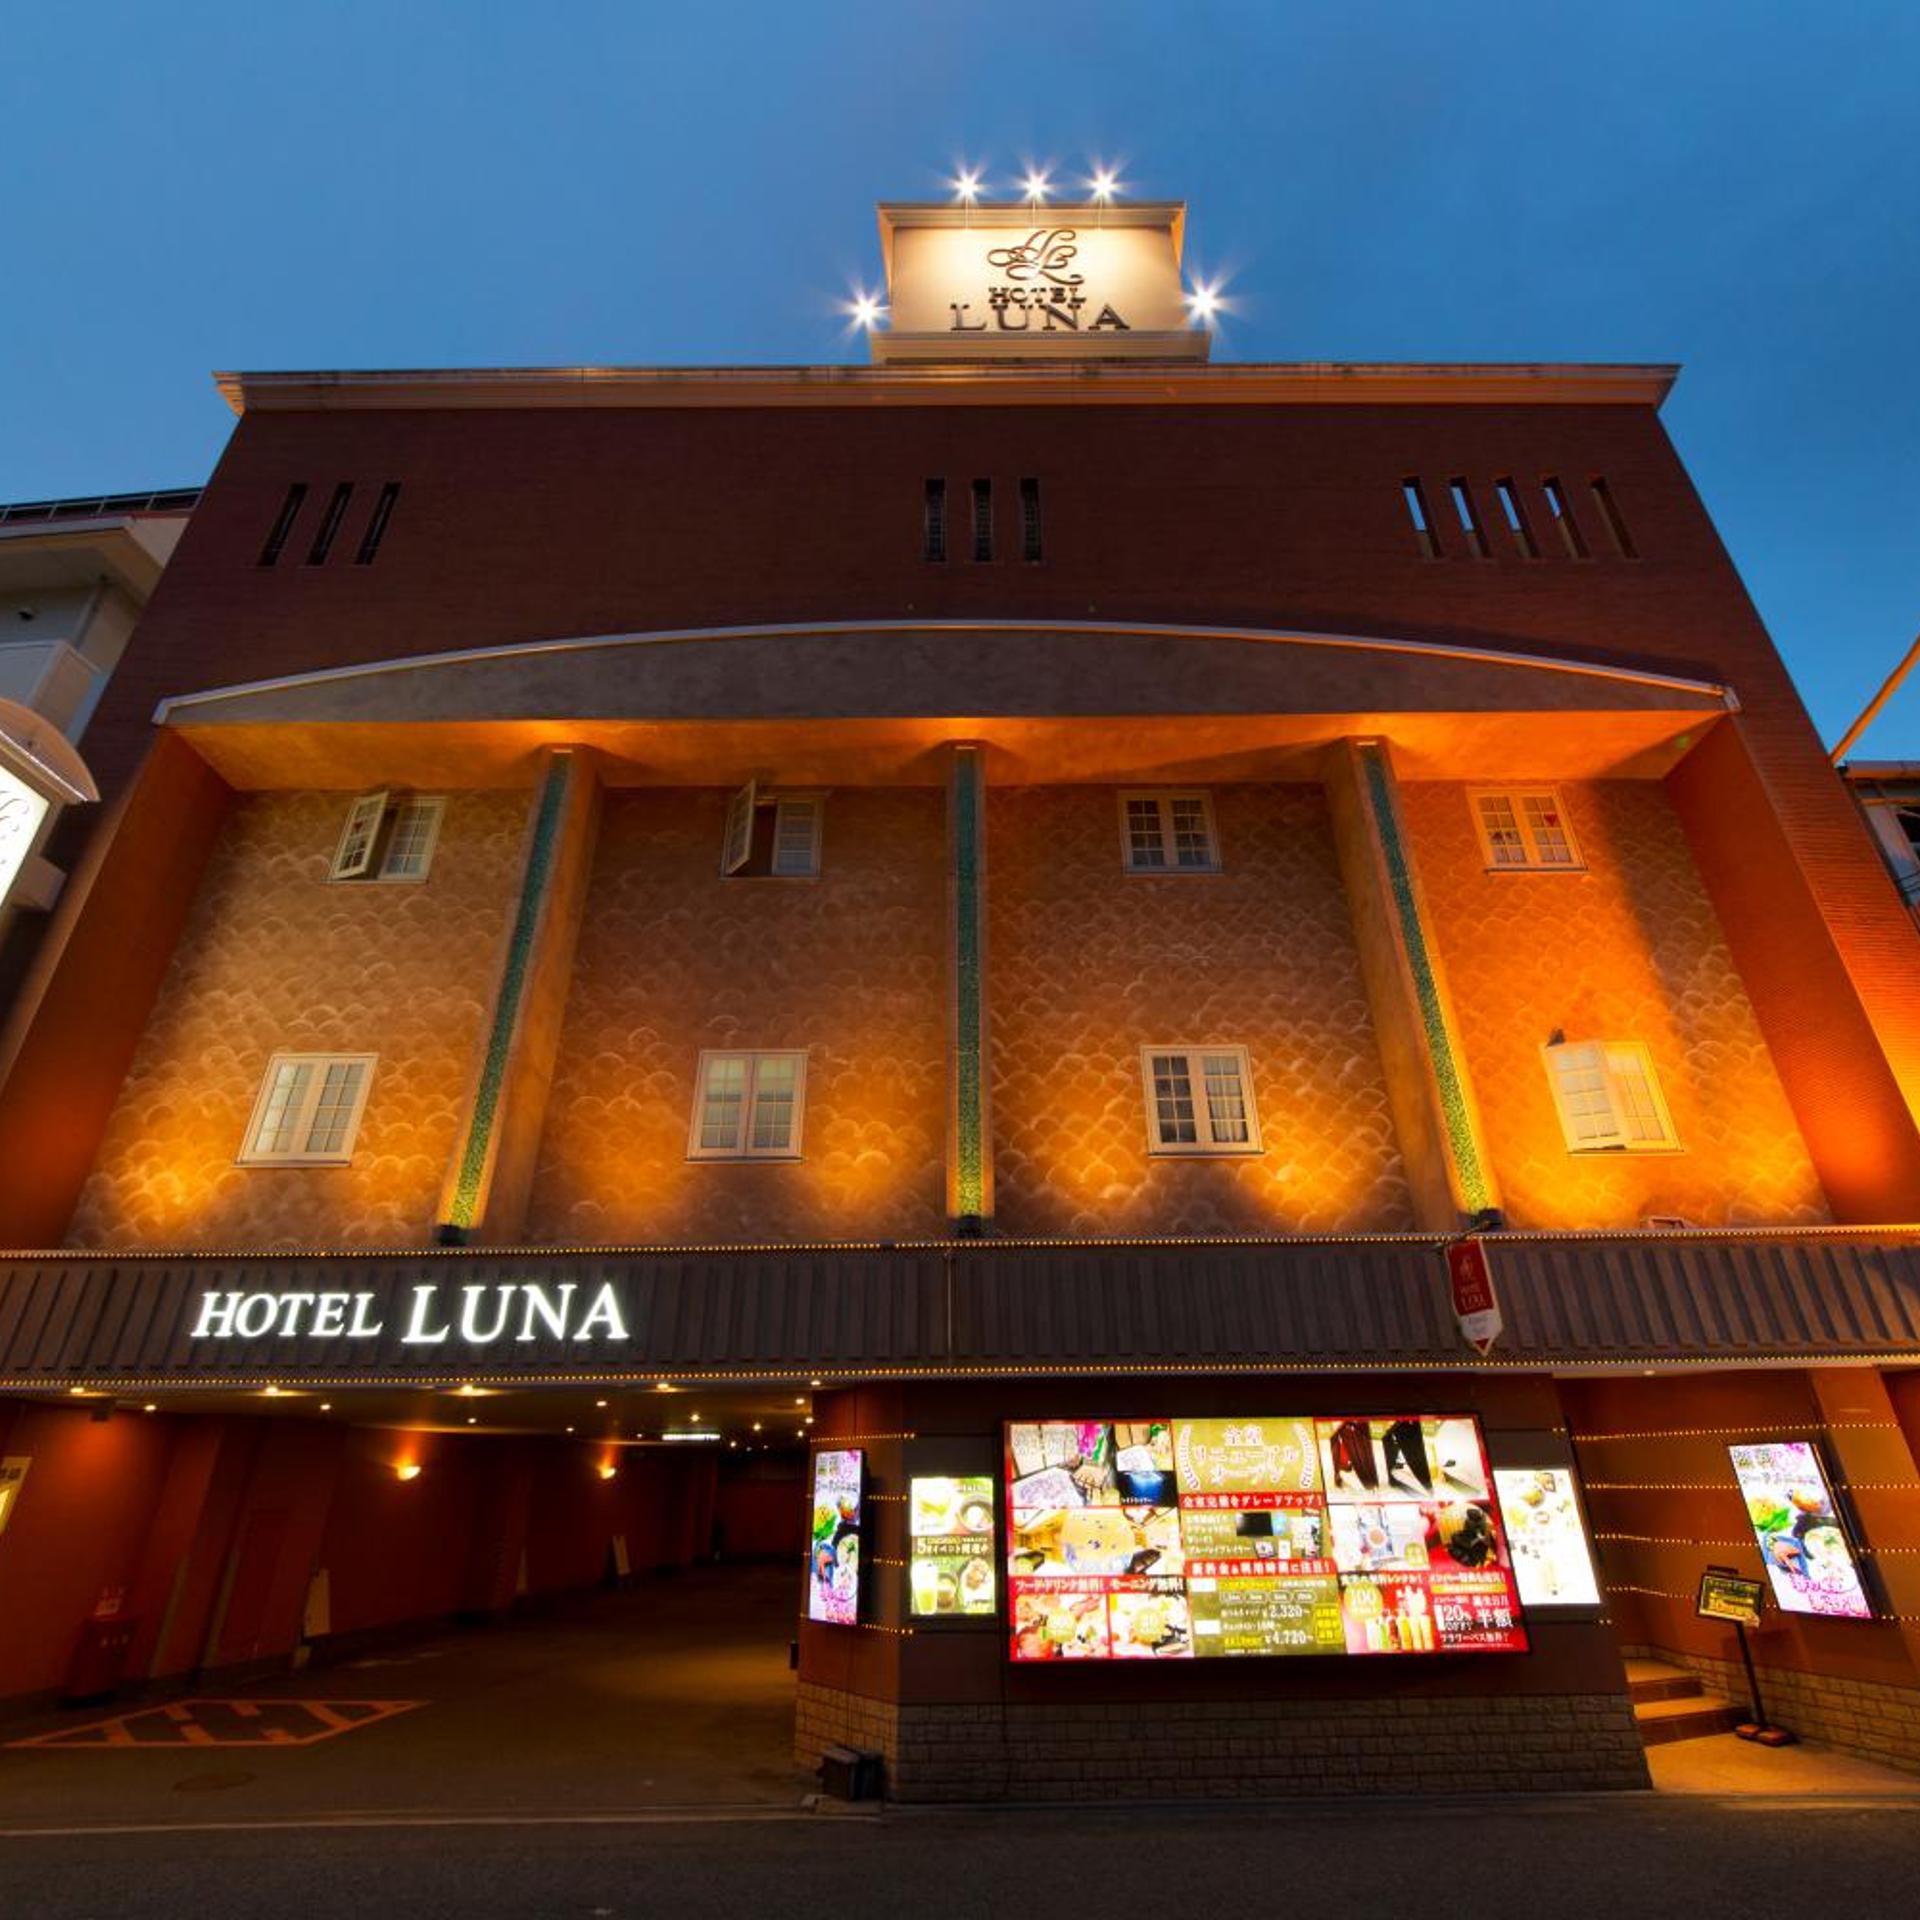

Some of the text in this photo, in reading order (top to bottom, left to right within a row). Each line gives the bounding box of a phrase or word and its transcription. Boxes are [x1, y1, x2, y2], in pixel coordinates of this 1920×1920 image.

[988, 287, 1087, 304] HOTEL
[949, 304, 1131, 332] LUNA
[190, 1282, 630, 1345] HOTEL LUNA
[1476, 1606, 1513, 1629] 半額
